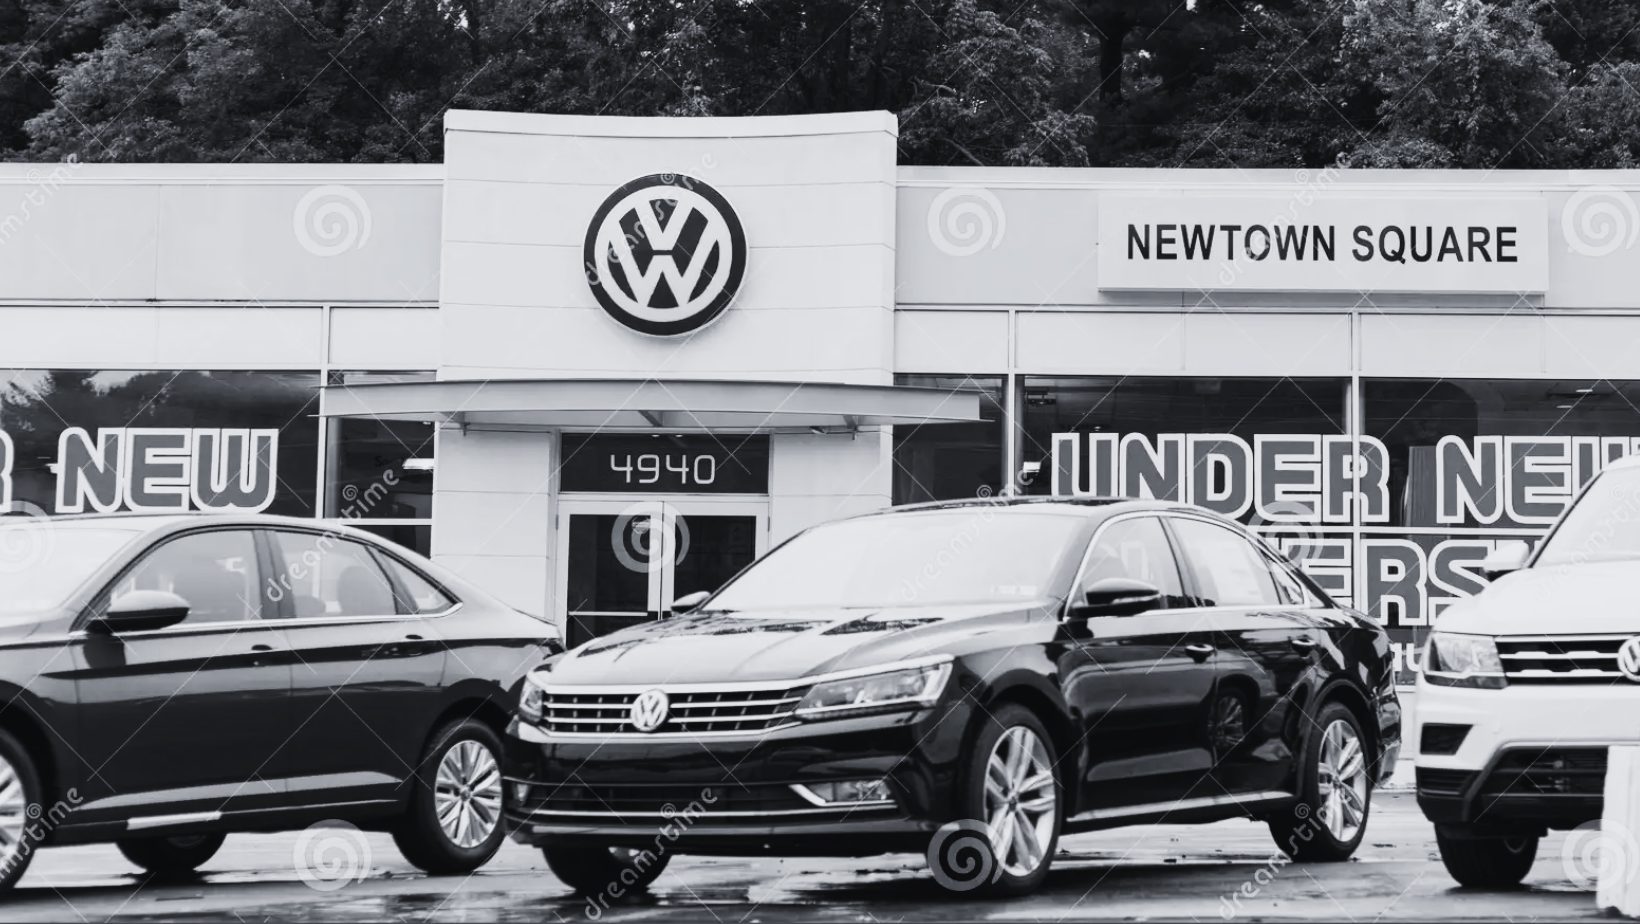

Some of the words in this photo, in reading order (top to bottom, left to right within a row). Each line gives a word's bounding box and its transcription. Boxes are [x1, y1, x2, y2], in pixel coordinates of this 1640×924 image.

[590, 183, 735, 325] VW
[1127, 223, 1336, 262] NEWTOWN
[1351, 224, 1519, 264] SQUARE
[55, 426, 280, 513] NEW
[610, 453, 716, 486] 4940
[1051, 432, 1391, 524] UNDER
